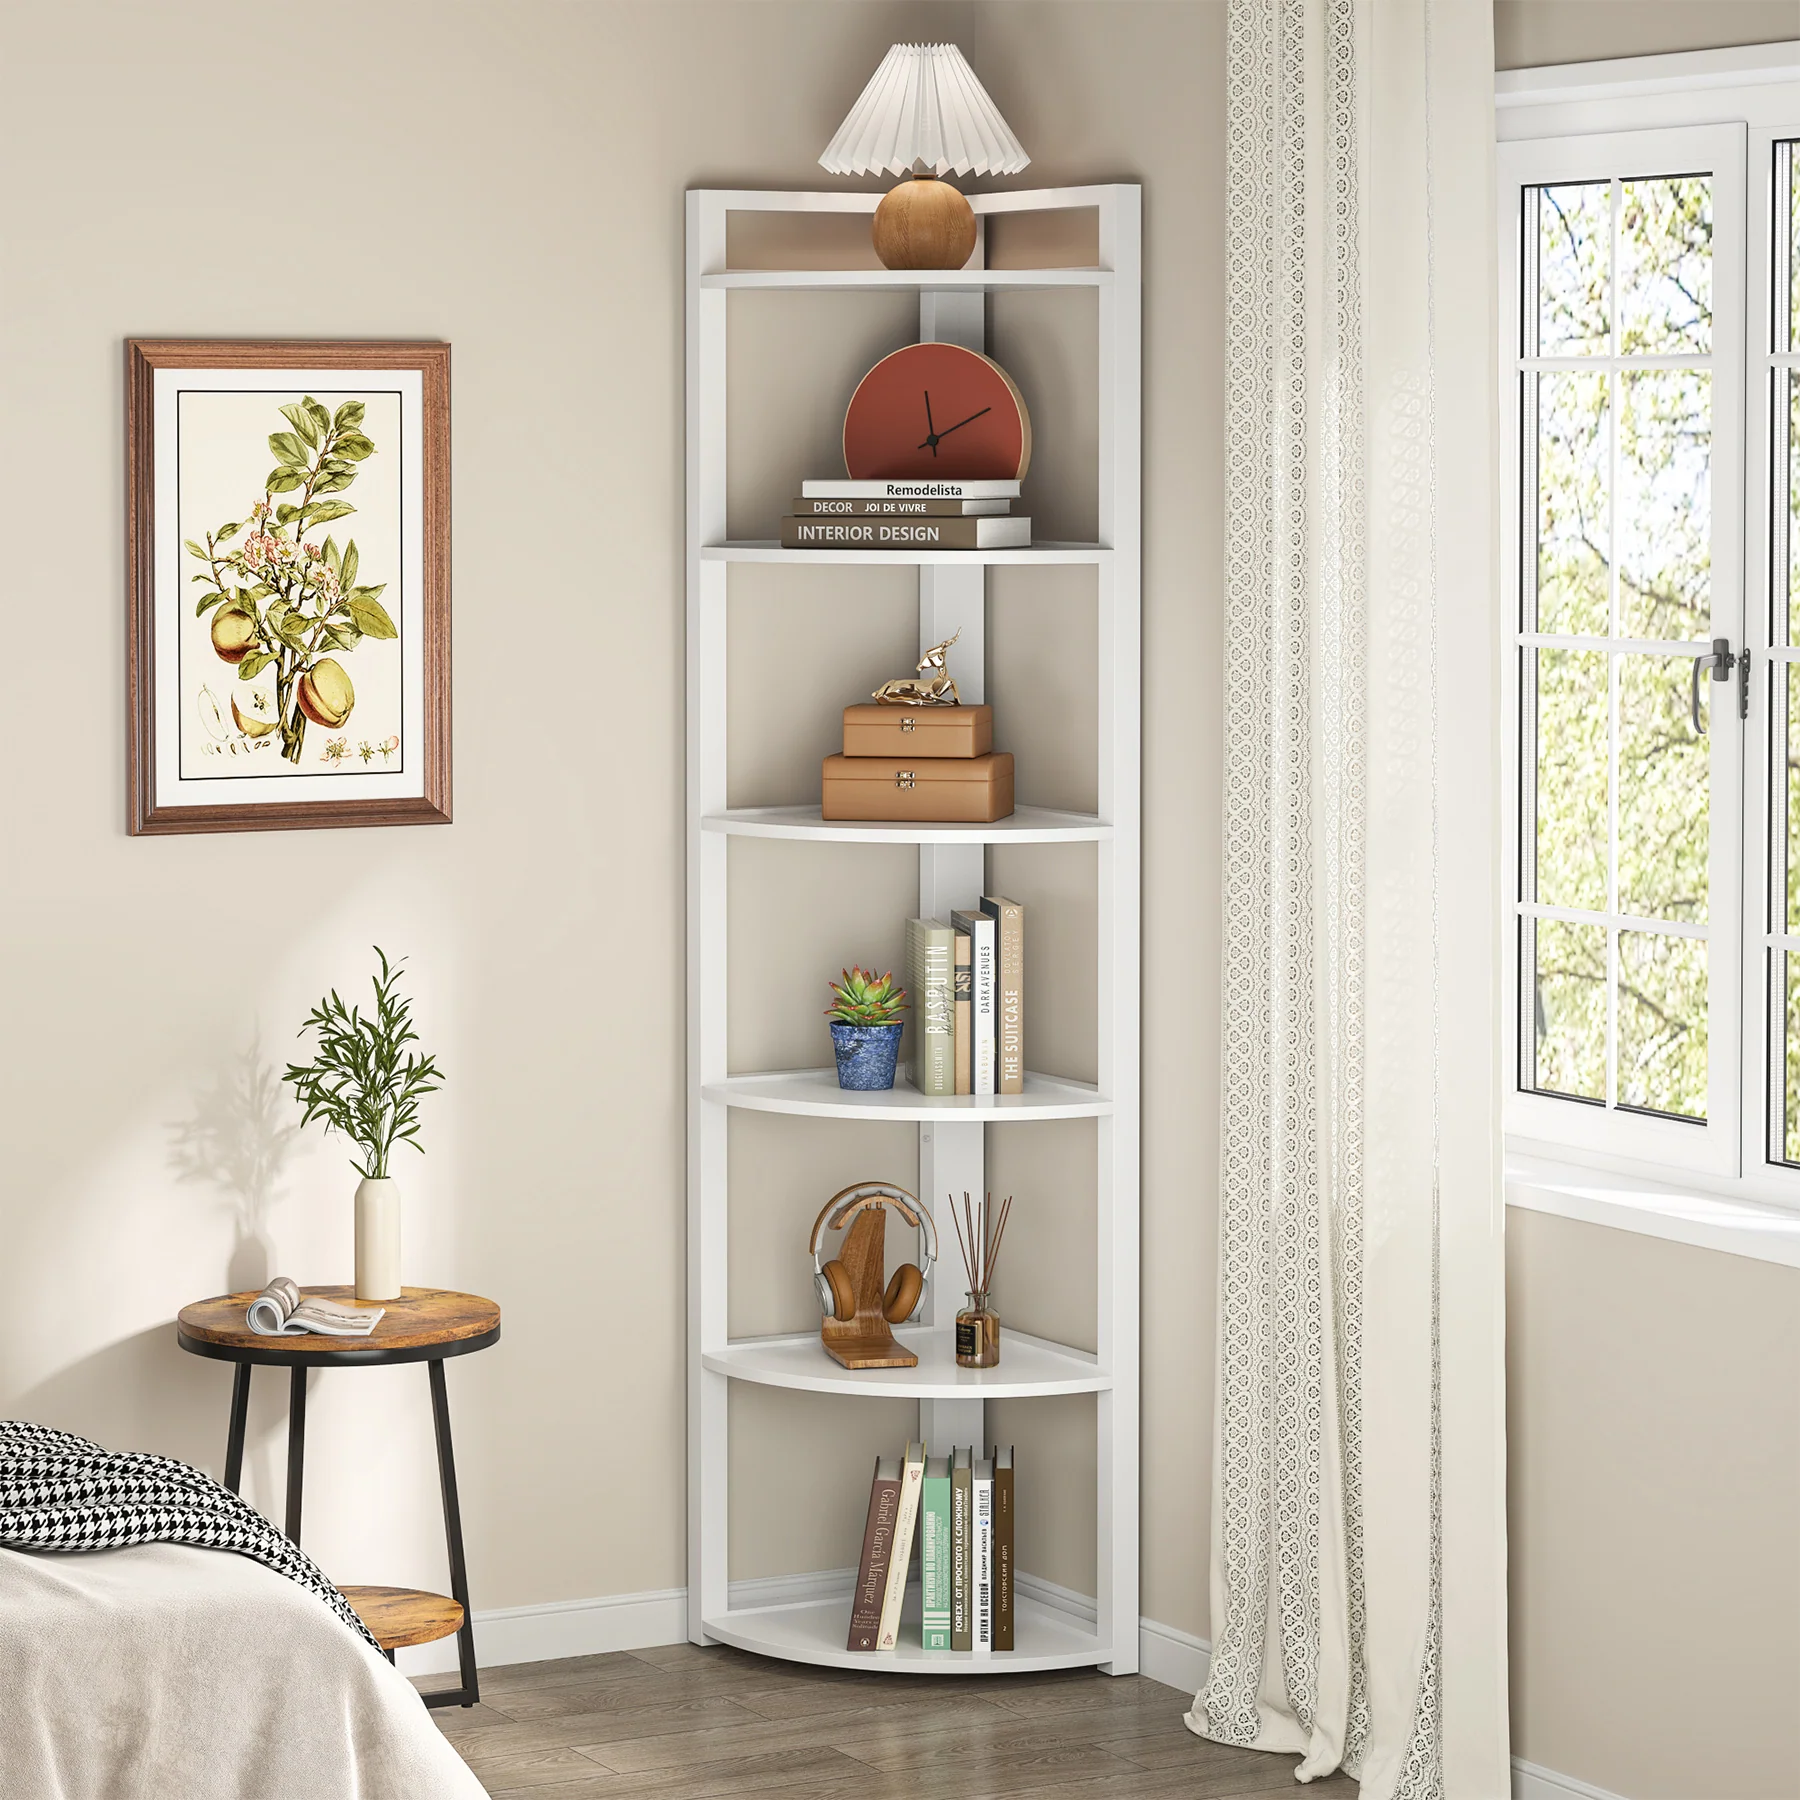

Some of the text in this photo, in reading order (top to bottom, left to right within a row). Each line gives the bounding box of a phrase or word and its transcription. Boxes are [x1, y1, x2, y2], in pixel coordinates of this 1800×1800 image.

[813, 502, 927, 513] DECOR JOI DE VIVRE
[886, 484, 963, 496] Remodelista
[797, 525, 940, 542] INTERIOR DESIGN
[1012, 930, 1020, 974] SERGEY
[925, 946, 948, 1034] RASPUTIN
[980, 945, 990, 1014] DARK AVENUES
[1005, 990, 1019, 1080] THE SUITCASE
[955, 1487, 963, 1537] СЛОЖНОМУ
[862, 1488, 896, 1604] Gabriel García Márquez
[925, 1562, 936, 1571] ПО
[955, 1545, 963, 1587] ПРОСТОГО
[955, 1588, 963, 1599] ОТ
[978, 1583, 989, 1642] ПРЯТКИ НА ОСЕВОЙ
[955, 1601, 963, 1633] FOREX:
